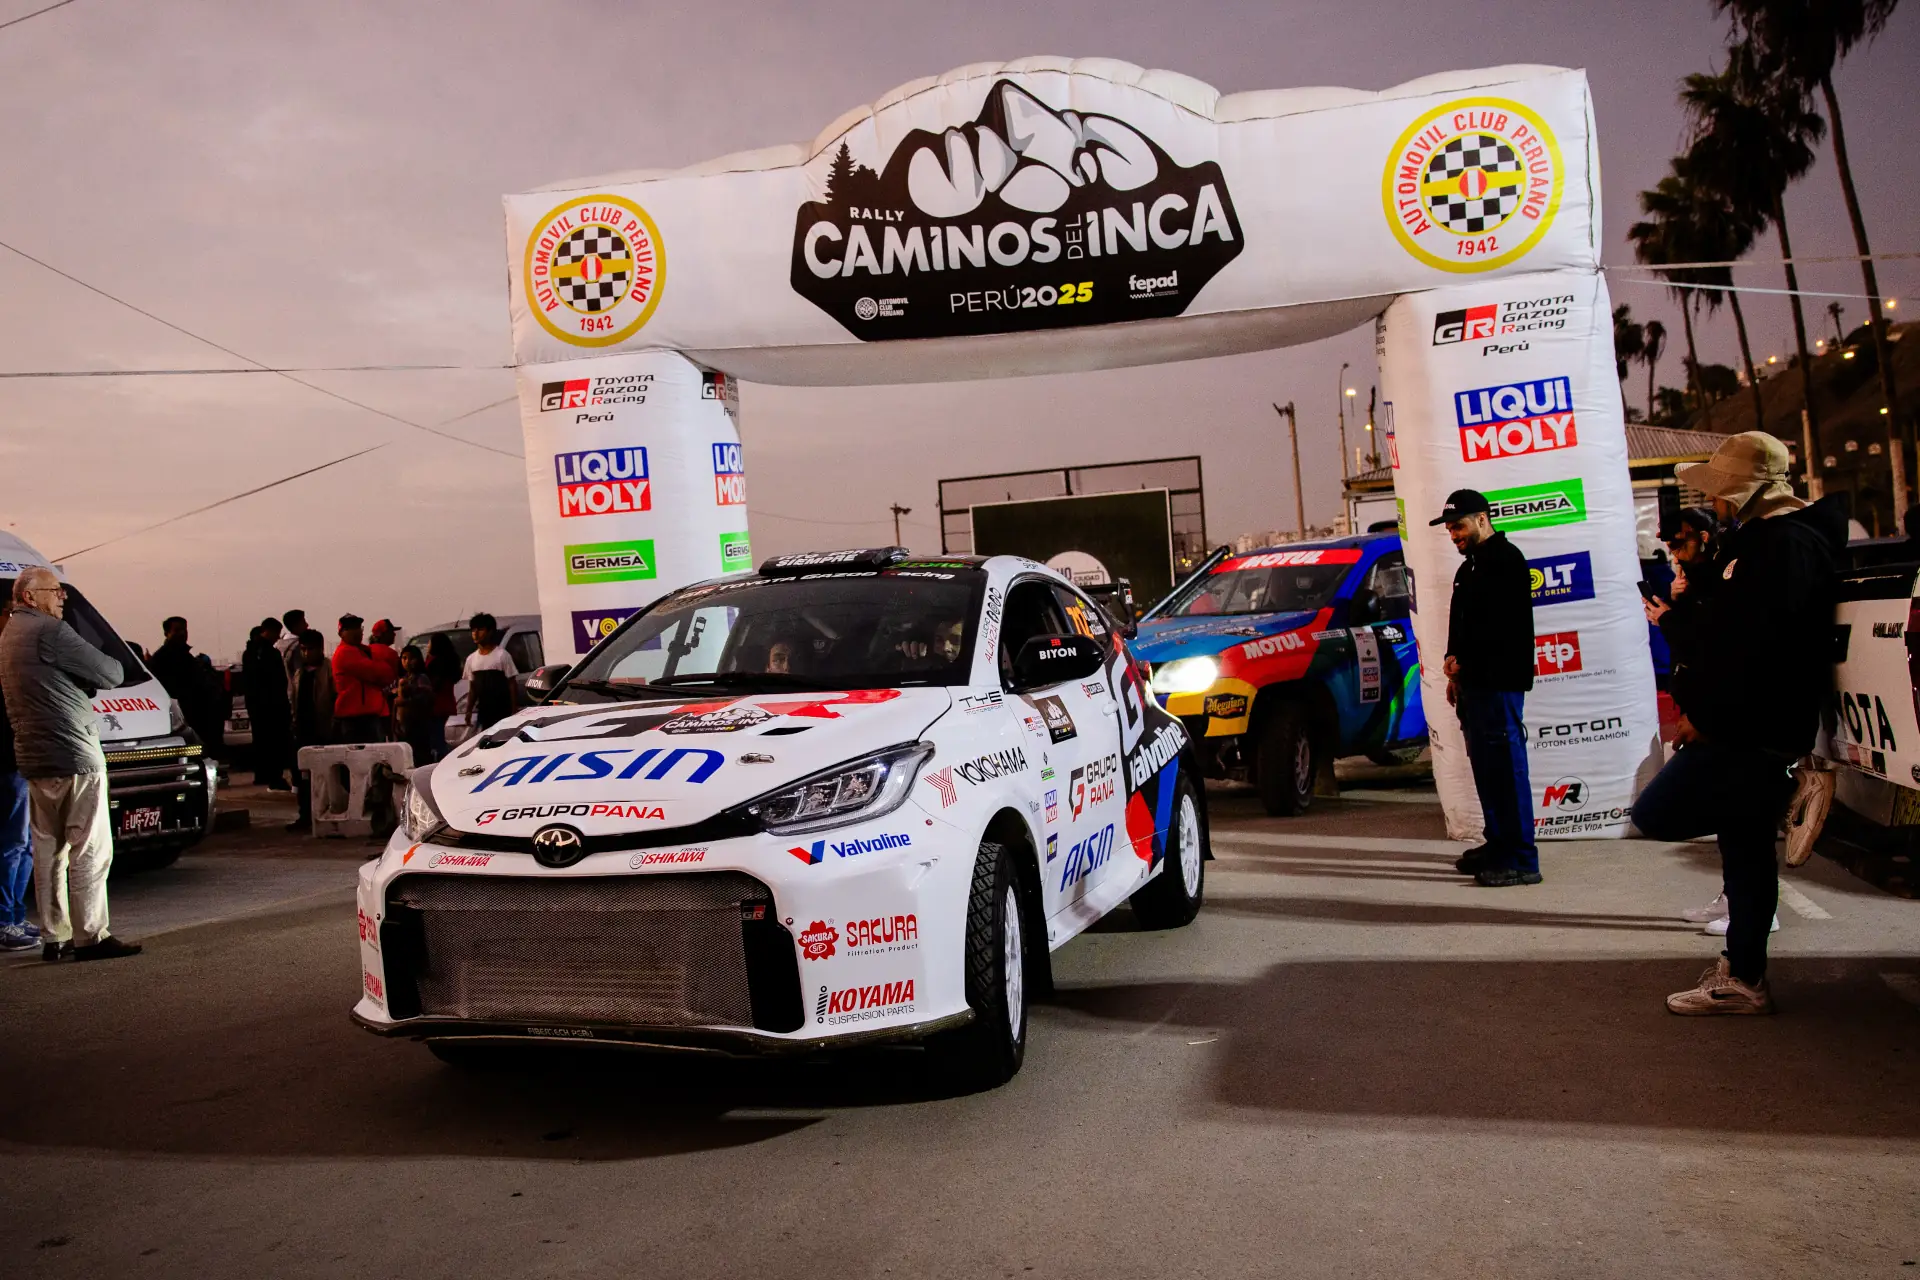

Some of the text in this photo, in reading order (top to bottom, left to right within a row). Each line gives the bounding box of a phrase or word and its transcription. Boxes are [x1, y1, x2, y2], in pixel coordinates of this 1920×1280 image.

[1398, 112, 1549, 236] AUTOMOVIL CLUB PERUANO
[849, 206, 904, 222] RALLY
[803, 183, 1234, 279] CAMINOS DEL INCA
[1457, 235, 1499, 256] 1942
[534, 206, 653, 312] AUTOMOVIL CLUB PERUANO
[1129, 270, 1177, 292] fepad
[1503, 294, 1574, 312] TOYOTA
[580, 315, 614, 332] 1942
[1502, 307, 1567, 323] GAZOO
[1435, 317, 1494, 344] GR
[1501, 319, 1565, 335] Racing
[1483, 340, 1530, 356] Perú
[593, 384, 648, 396] GAZOO
[595, 374, 655, 385] TOYOTA
[541, 389, 587, 412] GR
[591, 395, 645, 405] Racing
[1460, 379, 1568, 425] LIQUI
[576, 412, 614, 424] Perú
[1464, 413, 1573, 461] MOLY
[557, 449, 645, 484] LIQUI
[714, 445, 744, 474] LIQU
[560, 481, 649, 516] MOLY
[717, 475, 746, 504] MOL
[1488, 497, 1571, 518] GERMSA
[571, 555, 644, 569] GERMSA
[775, 554, 858, 567] SIEMPRE
[1238, 550, 1324, 569] MOTUL
[799, 571, 878, 580] GAZOO
[1531, 563, 1576, 590] OLT
[1545, 587, 1572, 597] DRINK
[984, 625, 998, 664] ALAYZA
[1039, 647, 1077, 660] BIYON
[1242, 632, 1306, 660] MOTUL
[958, 690, 1003, 706] TYE
[664, 717, 769, 729] CAMINOS INC
[1838, 690, 1896, 752] OTA
[1569, 737, 1580, 745] ES
[469, 748, 725, 795] AISIN
[954, 746, 1029, 786] YOKOHAMA
[1086, 753, 1117, 784] GRUPO
[1090, 782, 1115, 808] PANA
[1542, 783, 1582, 807] MR
[1533, 807, 1632, 827] TIREPUESTOS
[1537, 825, 1570, 836] FRENOS
[830, 833, 912, 858] Valvoline
[437, 855, 491, 866] ISHIKAWA
[642, 851, 706, 864] ISHIKAWA
[1060, 823, 1115, 892] AISIN
[802, 931, 833, 944] SAKURA
[847, 914, 917, 947] SAKURA
[847, 943, 918, 957] Filtration Product
[828, 979, 915, 1014] KOYAMA
[828, 1004, 915, 1026] SUSPENSION PARTS
